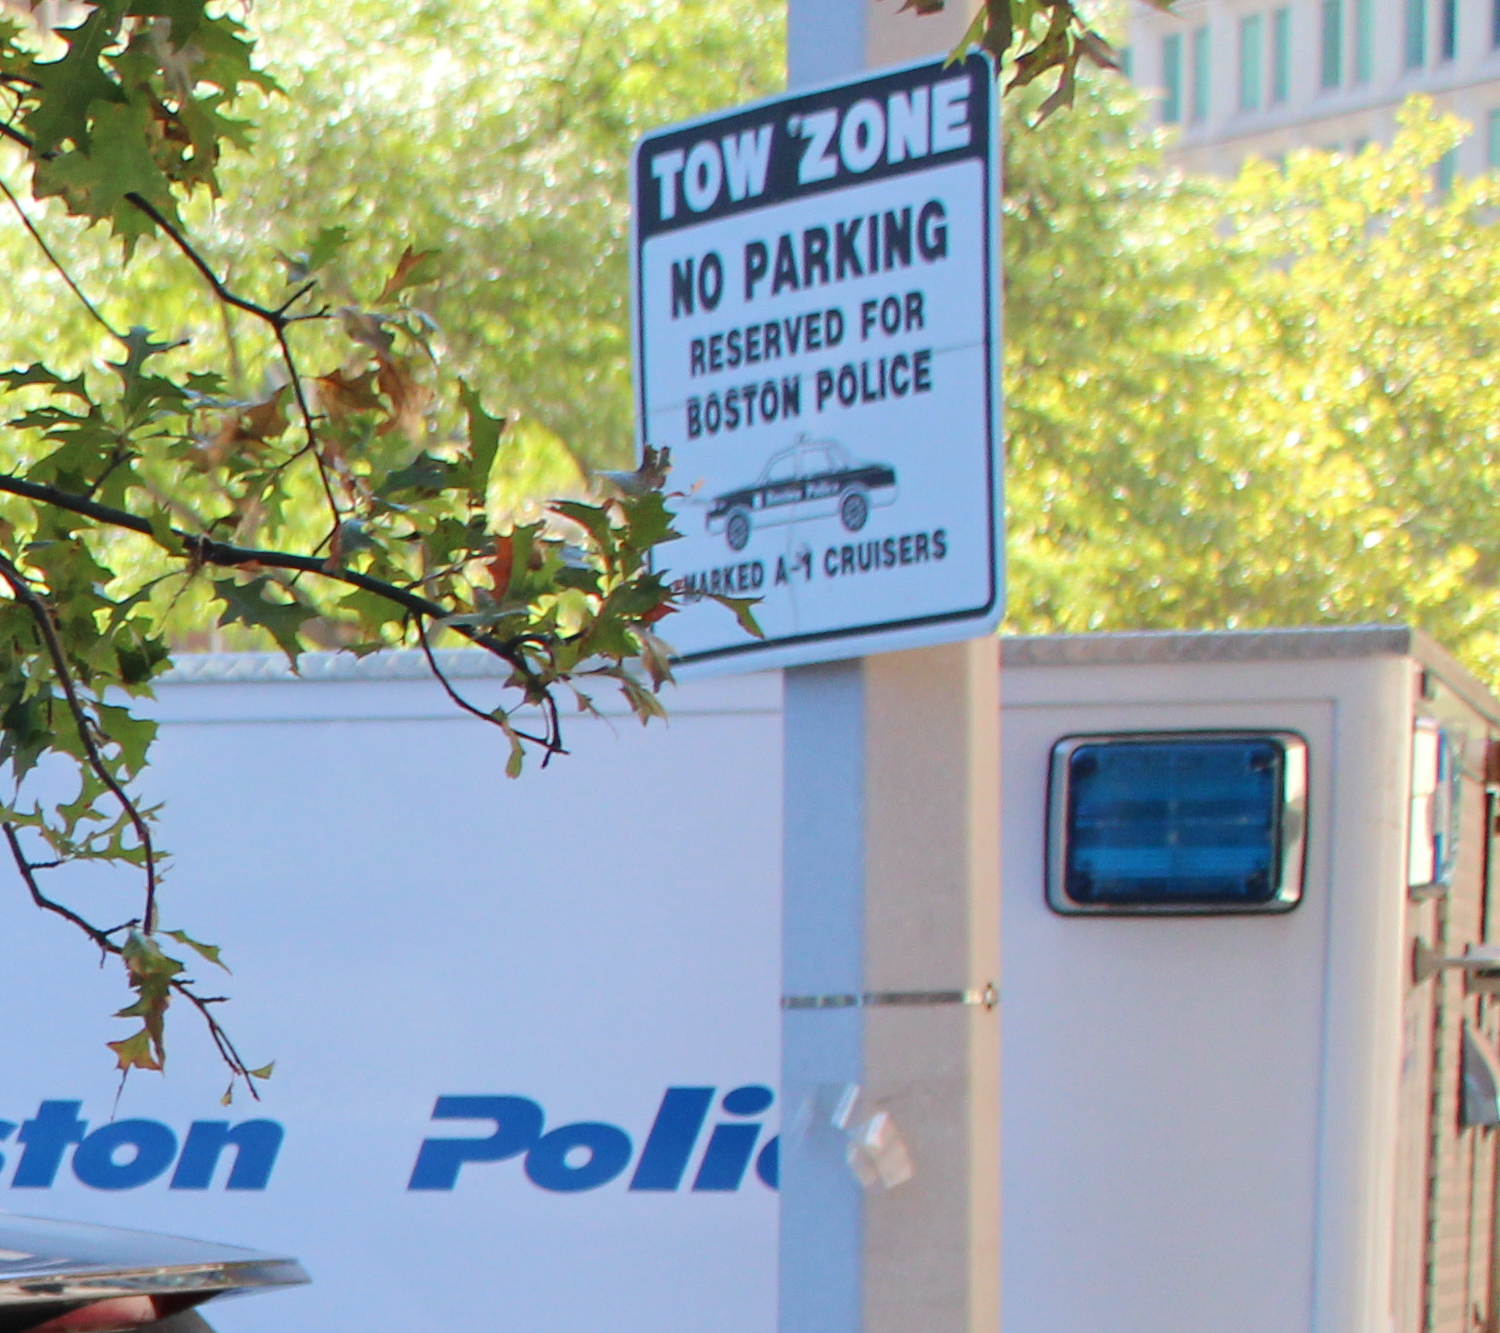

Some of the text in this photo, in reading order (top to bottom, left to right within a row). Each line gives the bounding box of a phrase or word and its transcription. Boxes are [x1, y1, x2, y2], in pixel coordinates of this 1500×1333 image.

[651, 73, 974, 222] TOW ZONE
[670, 197, 949, 321] NO PARKING
[689, 290, 925, 378] RESERVED FOR
[687, 349, 933, 440] BOSTON POLICE
[774, 550, 812, 586] A-1
[822, 528, 948, 578] CRUISERS
[405, 1084, 781, 1195] Poli
